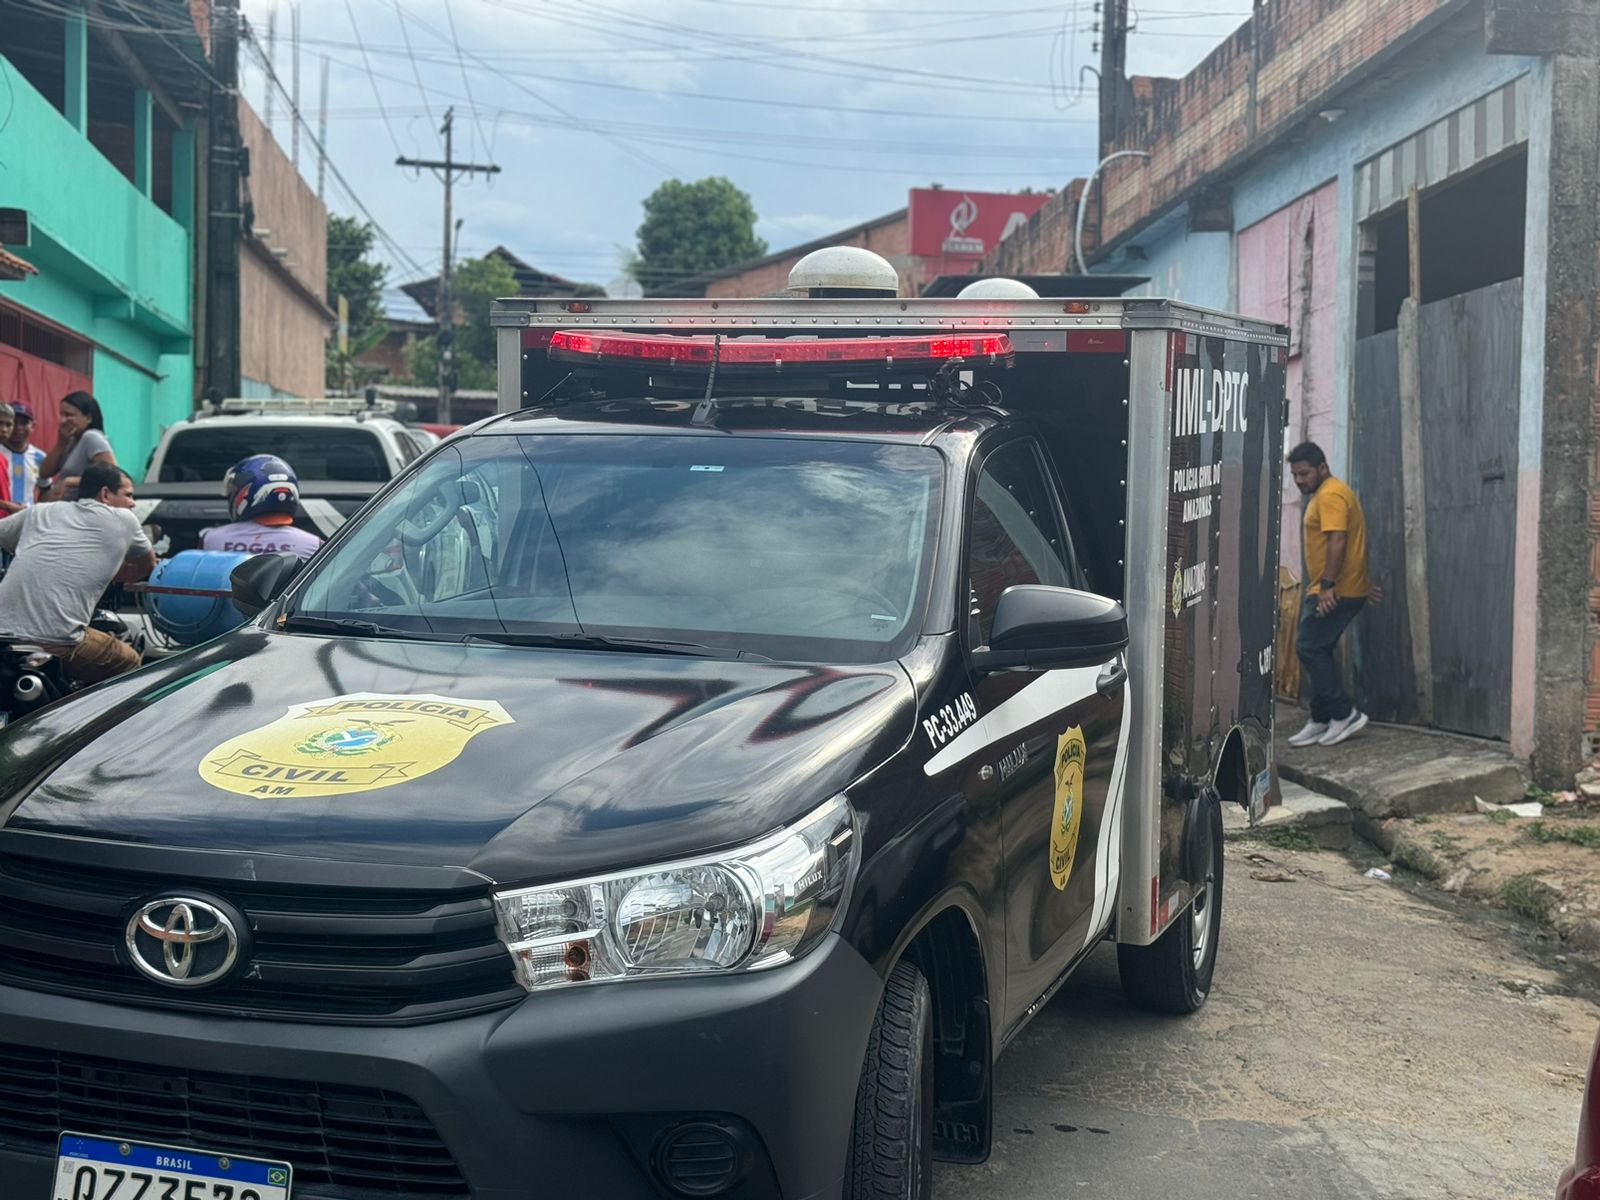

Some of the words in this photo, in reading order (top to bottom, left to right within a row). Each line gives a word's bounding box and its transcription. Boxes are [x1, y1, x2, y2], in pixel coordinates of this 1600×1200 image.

[1175, 368, 1249, 437] IML-DPTC
[341, 700, 471, 719] POLÍCIA
[922, 692, 977, 749] PC-33.449
[1061, 742, 1081, 768] POLÍCIA
[240, 764, 349, 782] CIVIL
[250, 784, 296, 796] AM
[798, 869, 823, 890] HILUX
[156, 1155, 193, 1170] BRASIL
